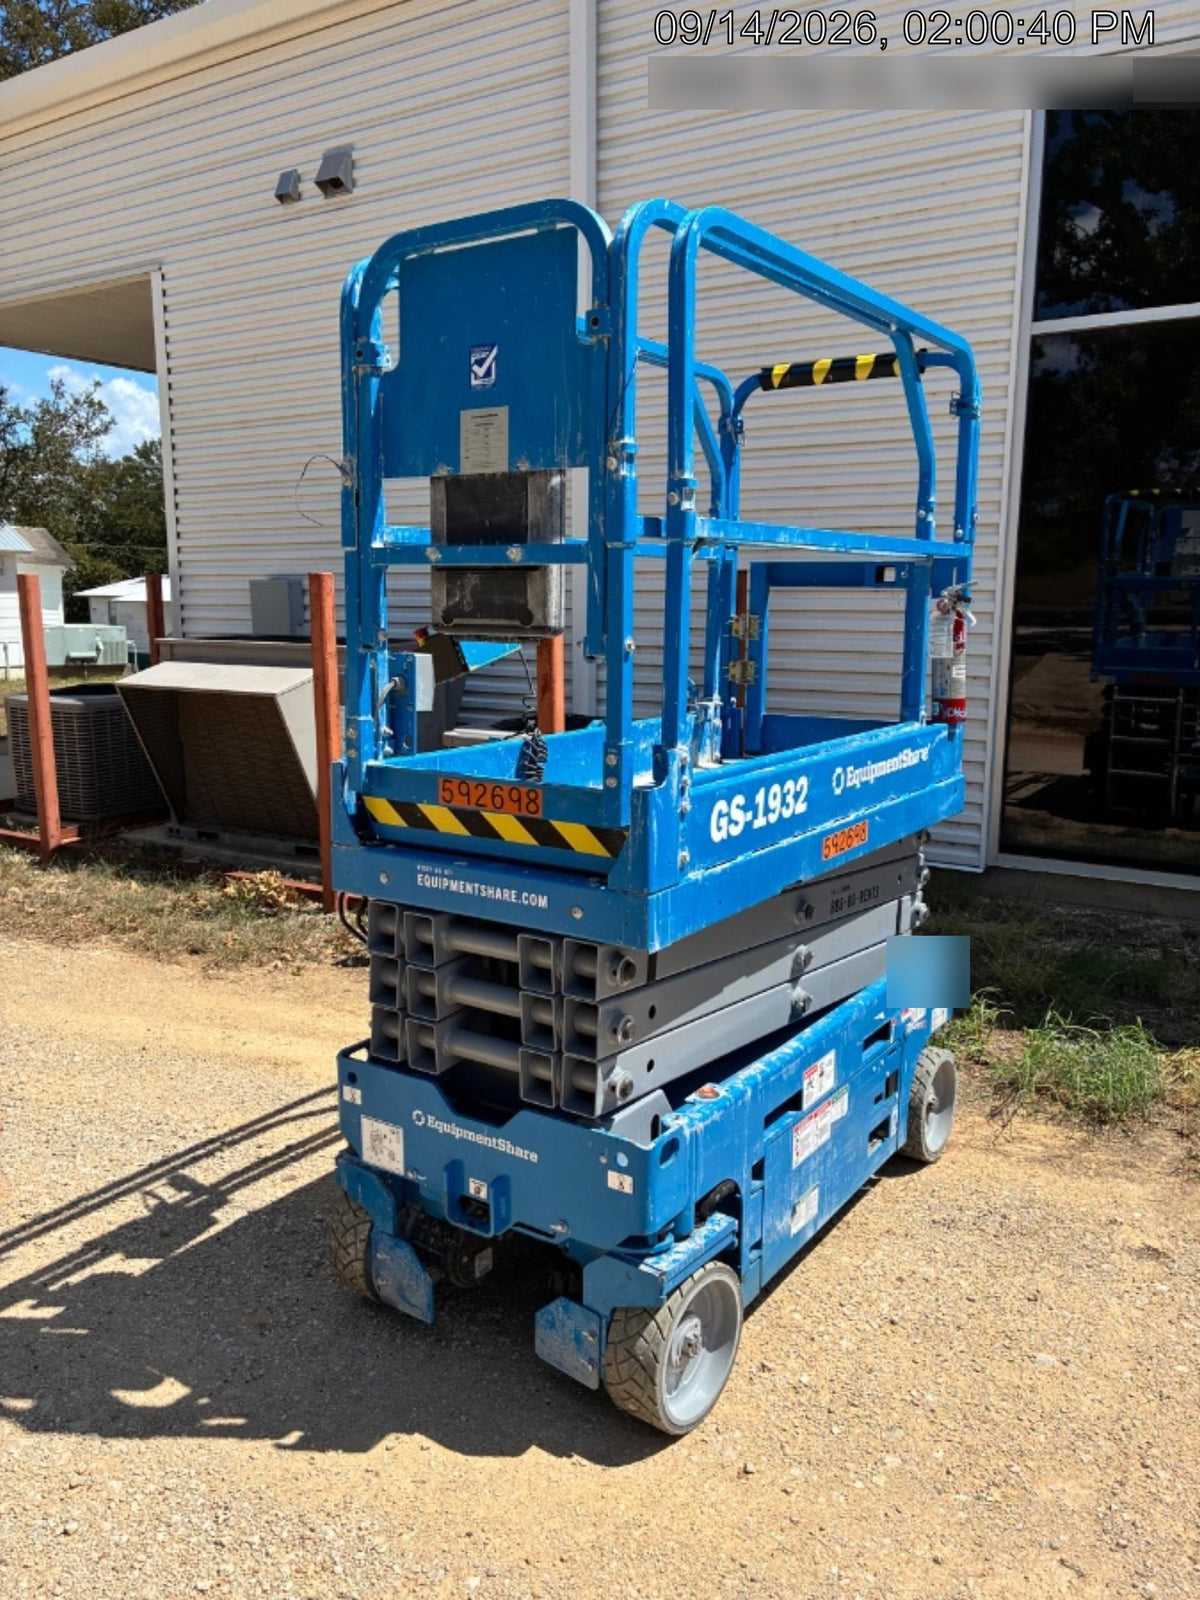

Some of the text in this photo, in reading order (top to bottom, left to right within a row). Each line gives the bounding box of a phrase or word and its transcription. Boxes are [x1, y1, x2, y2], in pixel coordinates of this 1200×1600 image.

[846, 747, 929, 789] EquipmentShare
[441, 779, 540, 815] 592698
[710, 775, 809, 843] GS-1932
[824, 821, 867, 859] 592698
[416, 873, 548, 909] EQUIPMENTSHARE.COM
[426, 1114, 539, 1163] EquipmentShare
